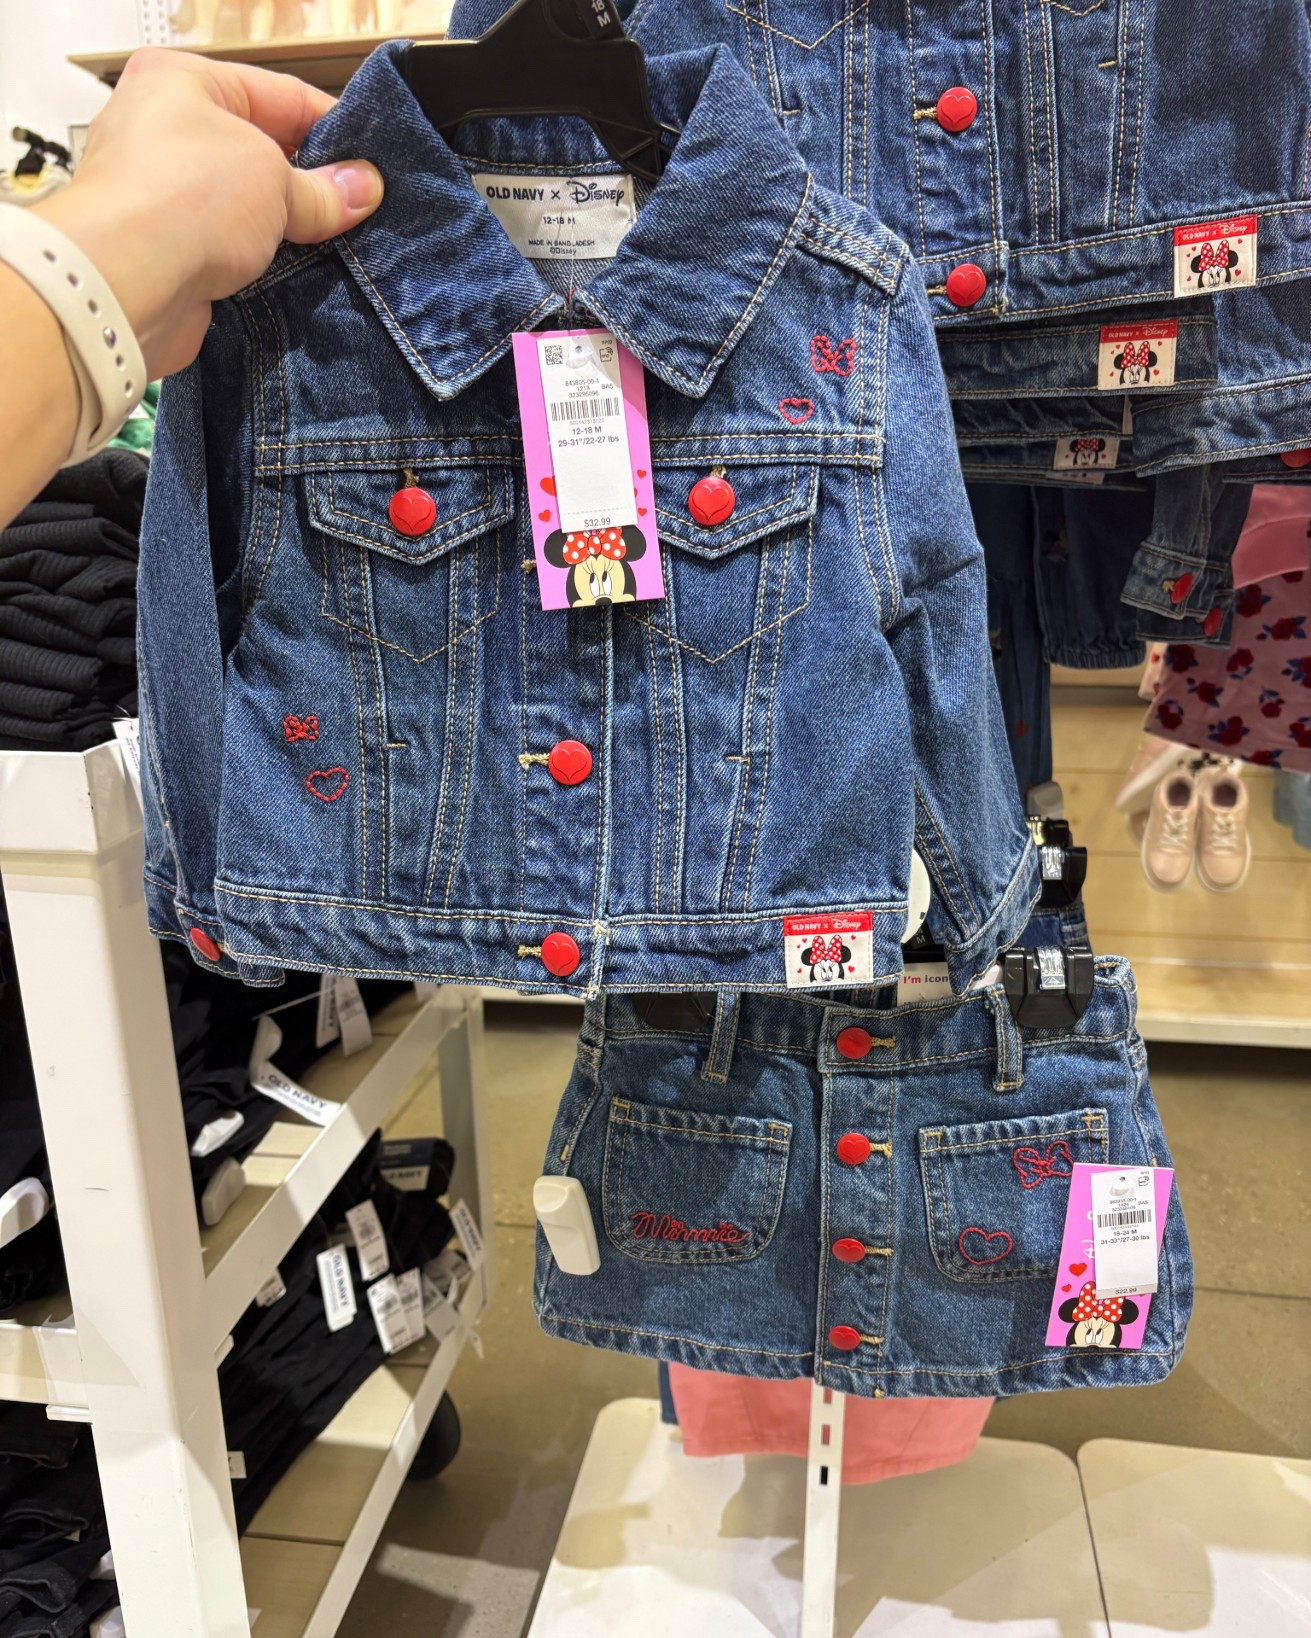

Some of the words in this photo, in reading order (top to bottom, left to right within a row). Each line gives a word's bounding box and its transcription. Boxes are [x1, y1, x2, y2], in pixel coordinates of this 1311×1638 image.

[597, 11, 611, 27] M
[486, 186, 511, 199] OLD
[513, 188, 545, 201] NAVY
[566, 180, 625, 206] Disney
[543, 216, 565, 225] 12-18
[567, 217, 576, 225] M
[1194, 231, 1210, 239] NAVY
[1218, 222, 1248, 234] Disney
[1142, 327, 1168, 337] Disney
[572, 427, 593, 436] 12-18
[594, 426, 602, 434] M
[607, 435, 620, 443] lbs
[583, 517, 611, 528] $32.99
[830, 919, 861, 931] Disney
[268, 1074, 292, 1094] OLD
[292, 1089, 328, 1110] NAVY
[630, 1211, 751, 1244] Minnie
